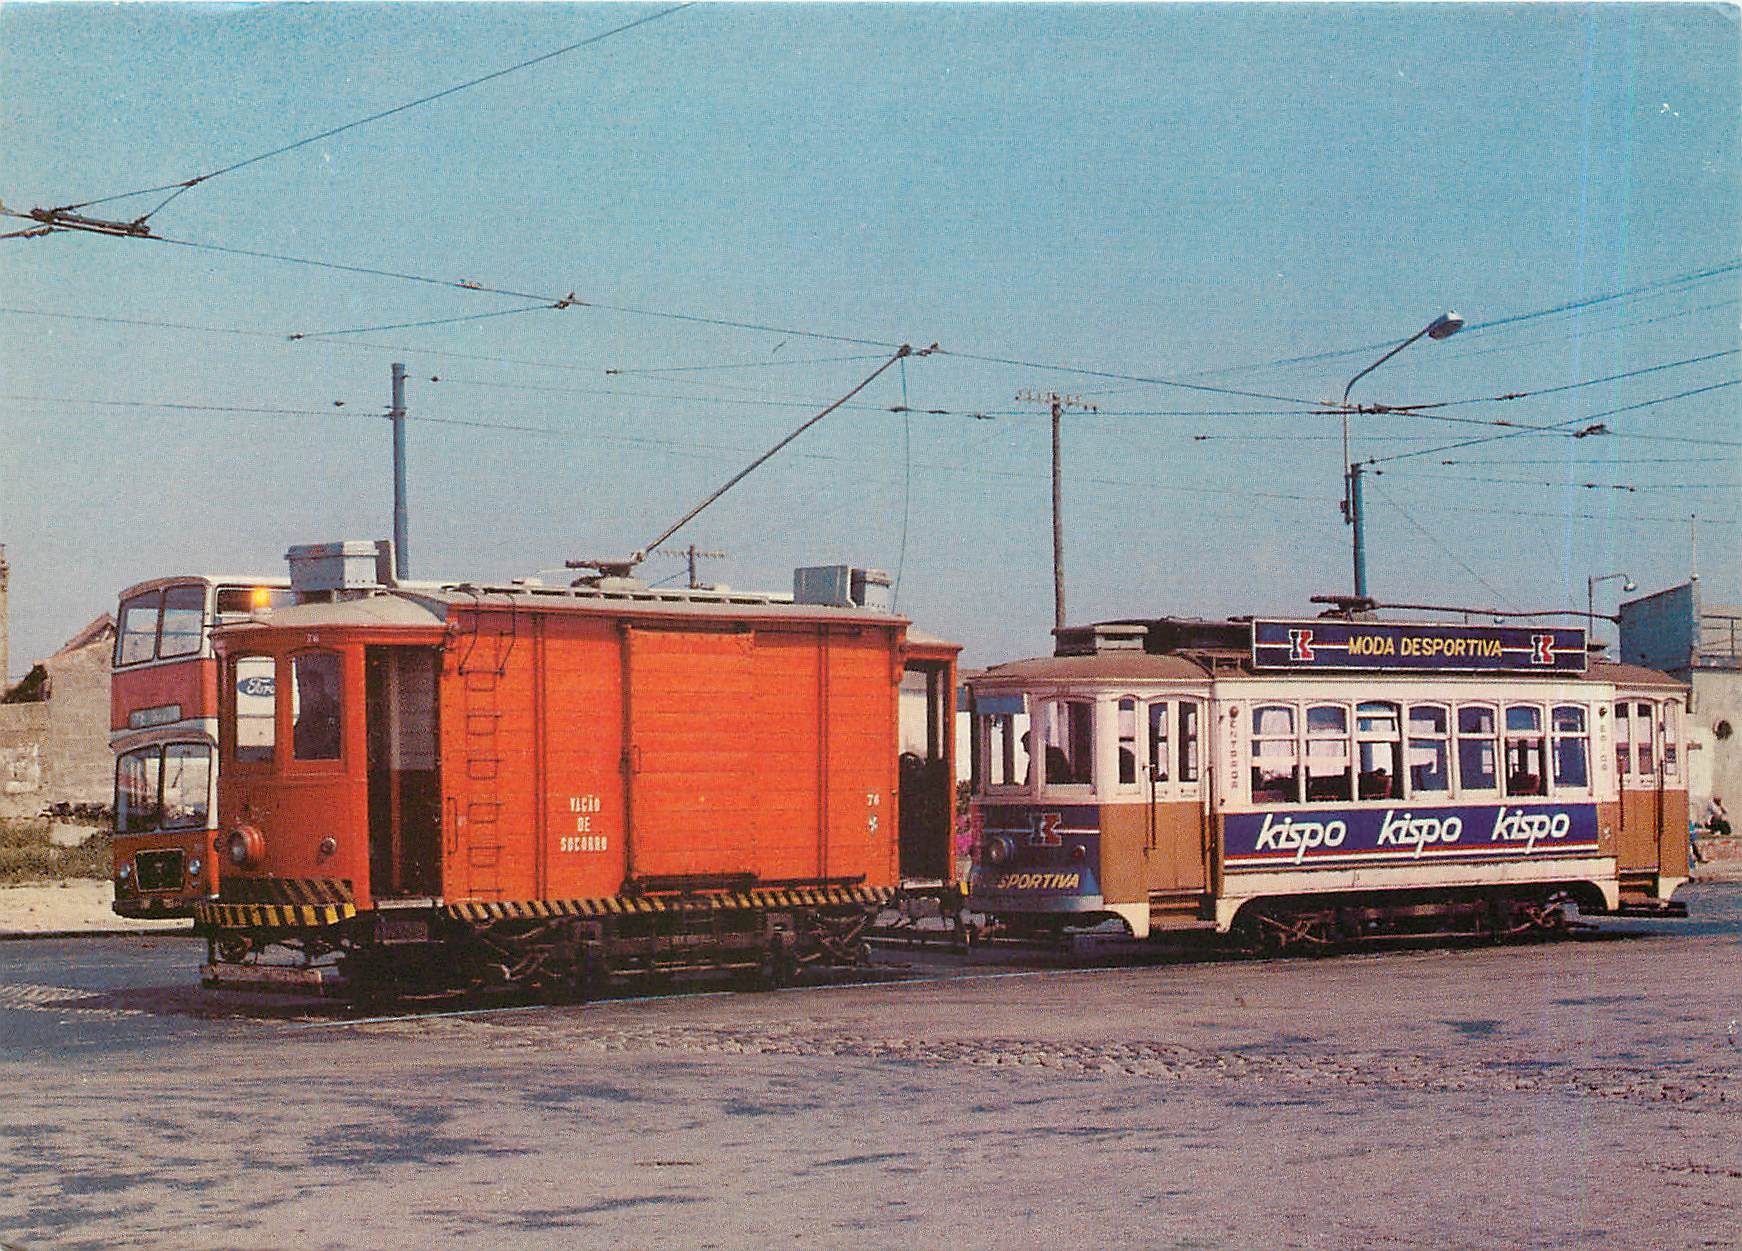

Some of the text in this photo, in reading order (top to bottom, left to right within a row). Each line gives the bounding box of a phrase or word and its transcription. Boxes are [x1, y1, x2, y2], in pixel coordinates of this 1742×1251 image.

[1349, 636, 1396, 656] MODA
[1401, 638, 1503, 657] DESPORTIVA
[577, 816, 590, 832] DE
[560, 836, 608, 851] SOCORRO
[1255, 807, 1571, 864] kispo kispo kispo
